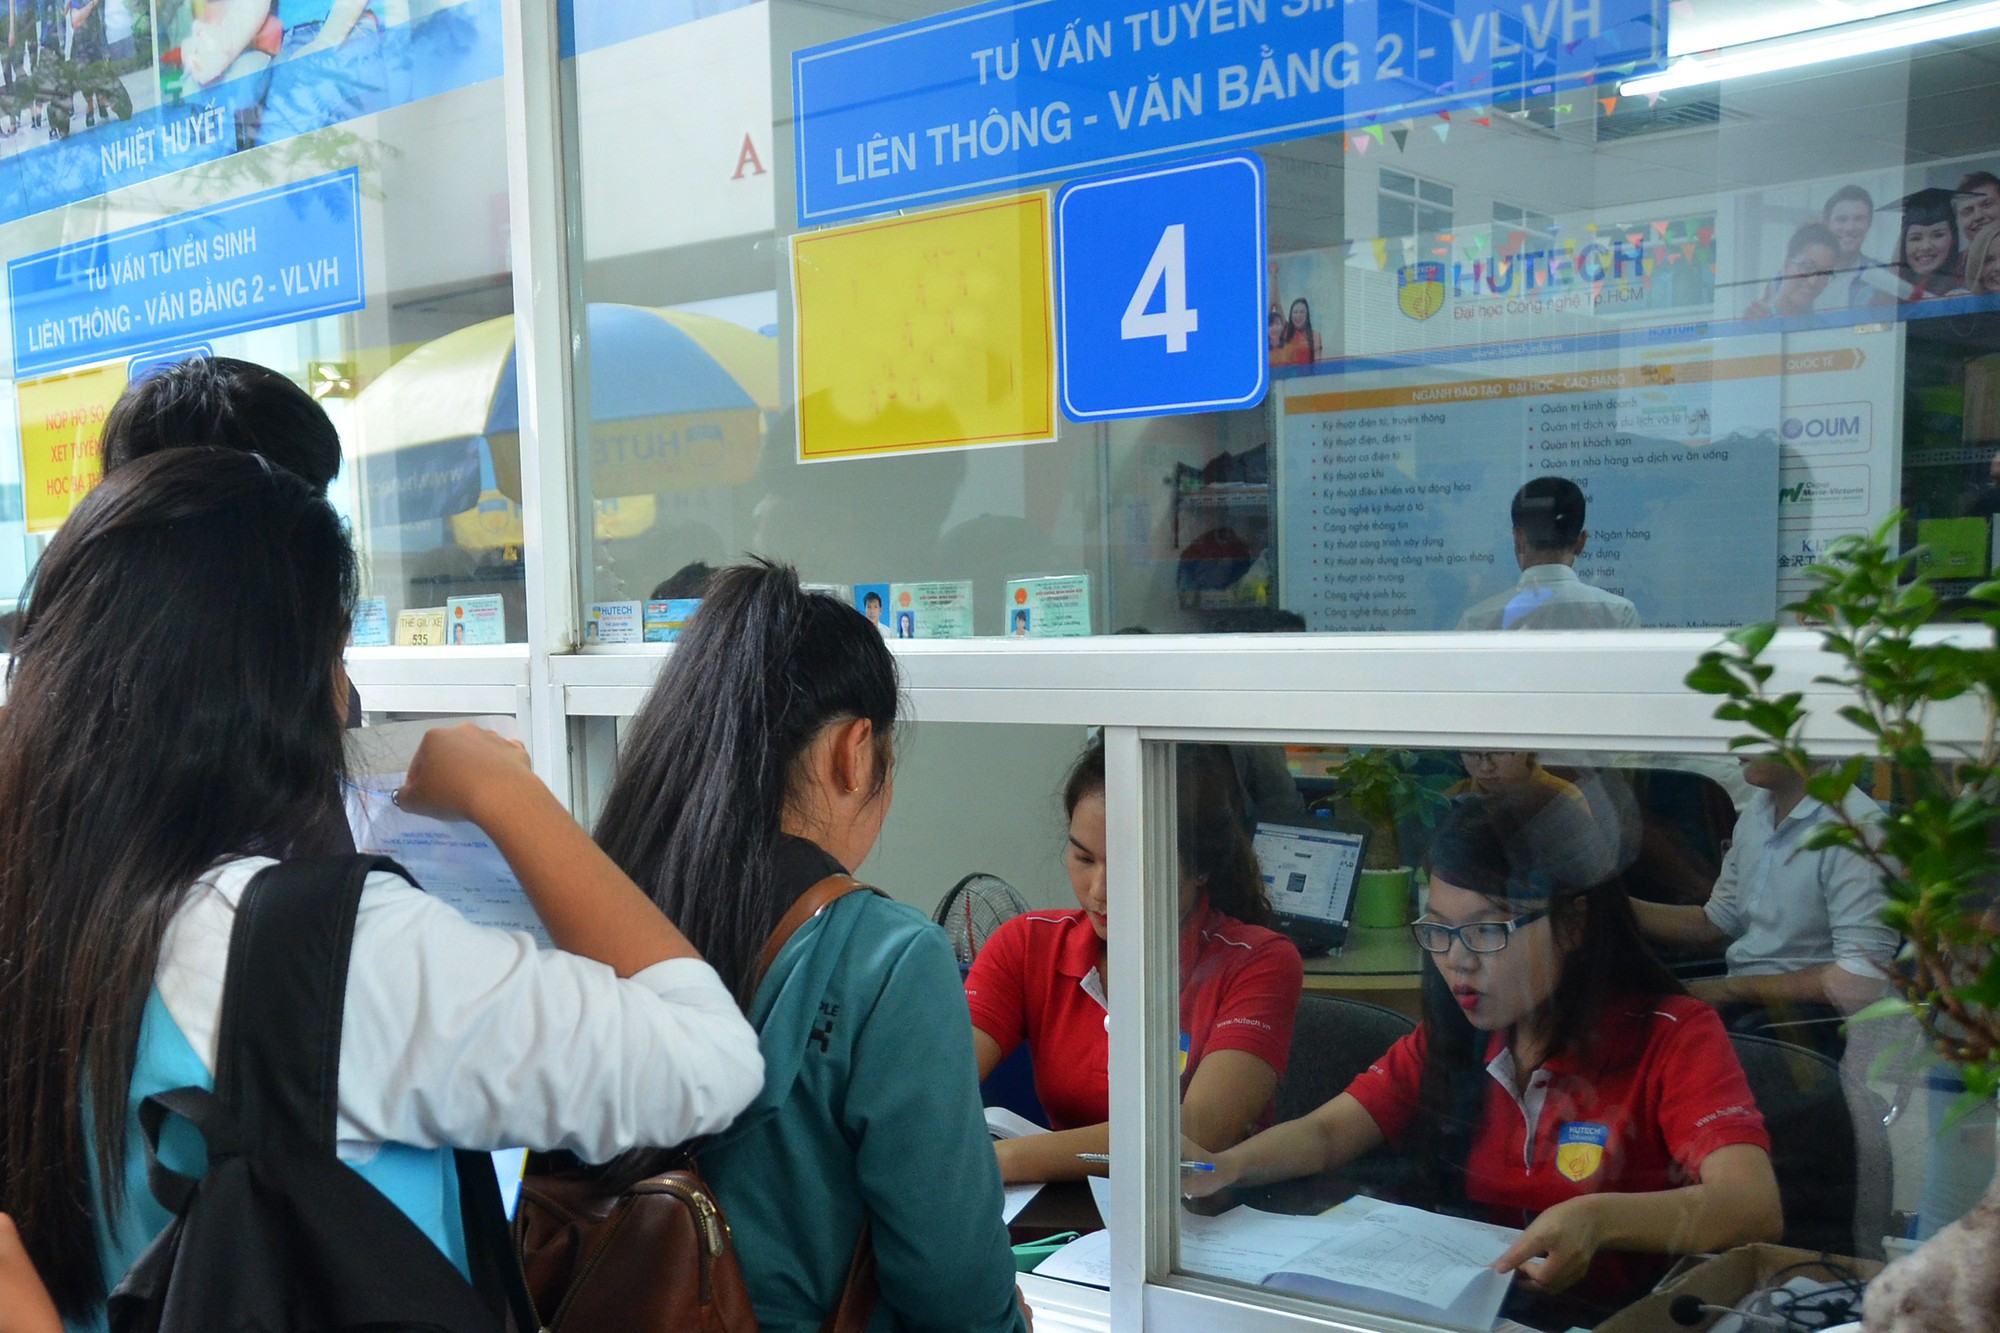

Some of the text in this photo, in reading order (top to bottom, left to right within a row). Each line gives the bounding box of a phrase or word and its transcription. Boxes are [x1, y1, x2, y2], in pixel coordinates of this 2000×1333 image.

[971, 37, 1020, 85] TƯ
[1031, 17, 1112, 72] VẤN
[835, 130, 917, 185] LIÊN
[926, 101, 1072, 166] THÔNG
[1108, 73, 1202, 131] VĂN
[1218, 42, 1361, 112] BẰNG
[1375, 33, 1404, 81] 2
[1449, 0, 1602, 64] VLVH
[100, 96, 226, 177] NHIỆT HUYẾT
[730, 132, 767, 181] A
[110, 252, 146, 286] VẤN
[148, 233, 209, 276] TUYỂN
[212, 226, 257, 262] SINH
[1453, 238, 1644, 297] HUTECH
[28, 318, 65, 352] LIÊN
[68, 306, 131, 343] THÔNG
[144, 291, 185, 326] VĂN
[189, 276, 247, 317] BẰNG
[251, 274, 264, 304] 2
[280, 256, 339, 297] VLVH
[1120, 223, 1198, 354] 4
[1454, 305, 1475, 320] Đại
[1479, 301, 1504, 319] học
[1804, 415, 1860, 438] OUM
[412, 633, 428, 646] 535
[600, 605, 633, 615] HUTECH
[1569, 1126, 1601, 1135] HUTECH
